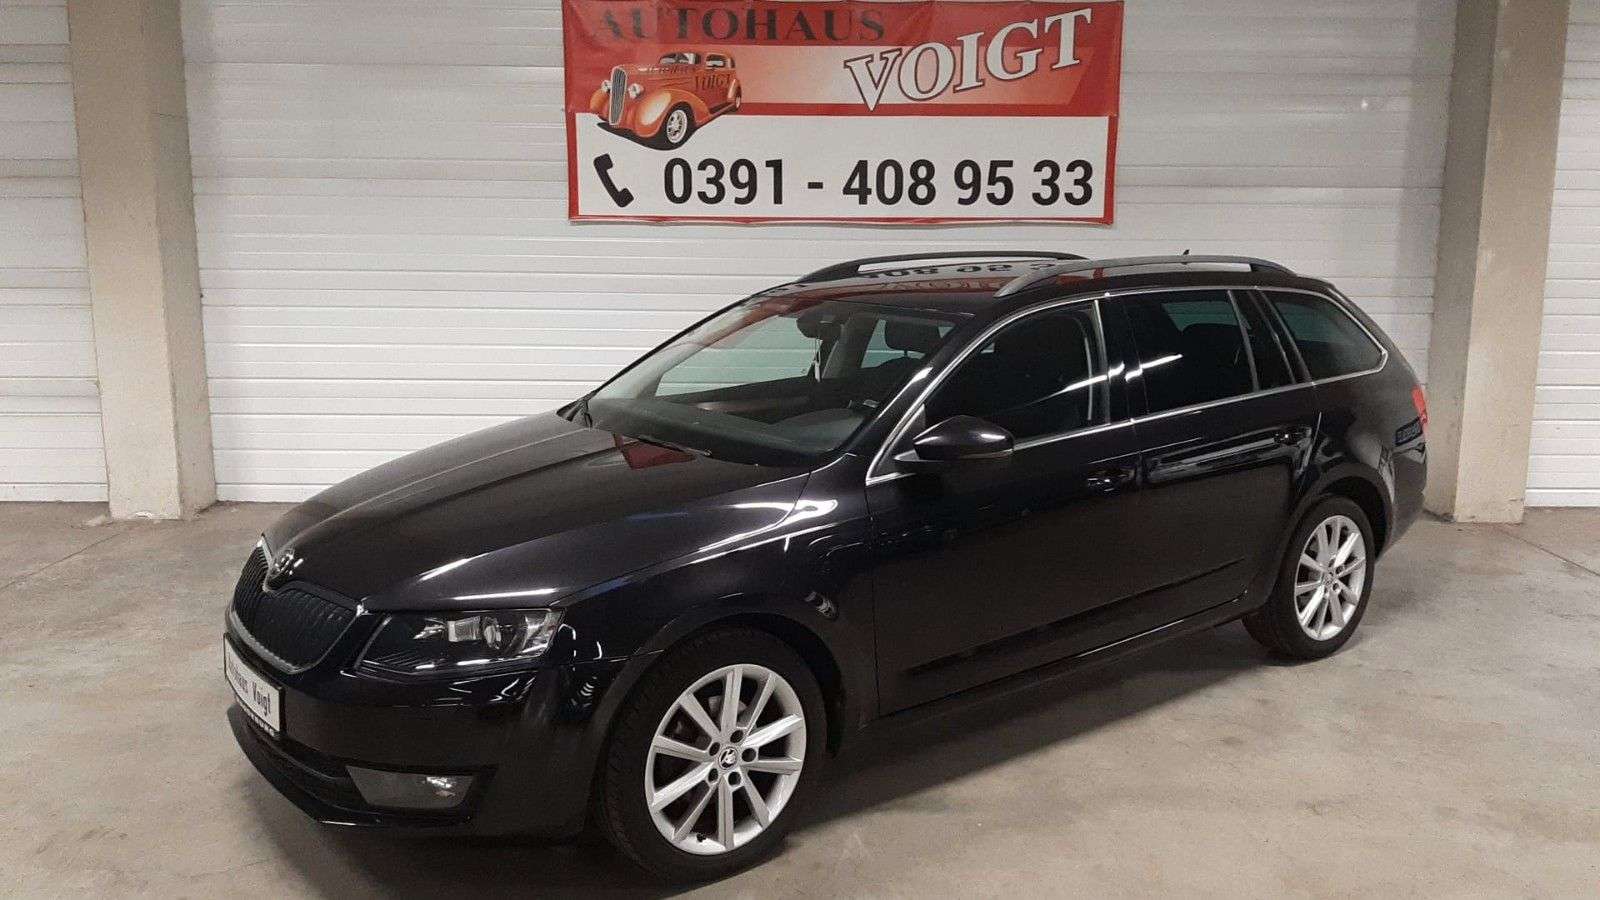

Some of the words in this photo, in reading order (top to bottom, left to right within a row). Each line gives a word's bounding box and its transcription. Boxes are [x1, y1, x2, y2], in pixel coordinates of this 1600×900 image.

[597, 8, 885, 41] AUTOHAUS
[843, 8, 1092, 111] VOIGT
[663, 157, 783, 206] 0391
[807, 181, 824, 190] -
[842, 159, 936, 206] 408
[953, 159, 1015, 206] 95
[1031, 159, 1093, 206] 33
